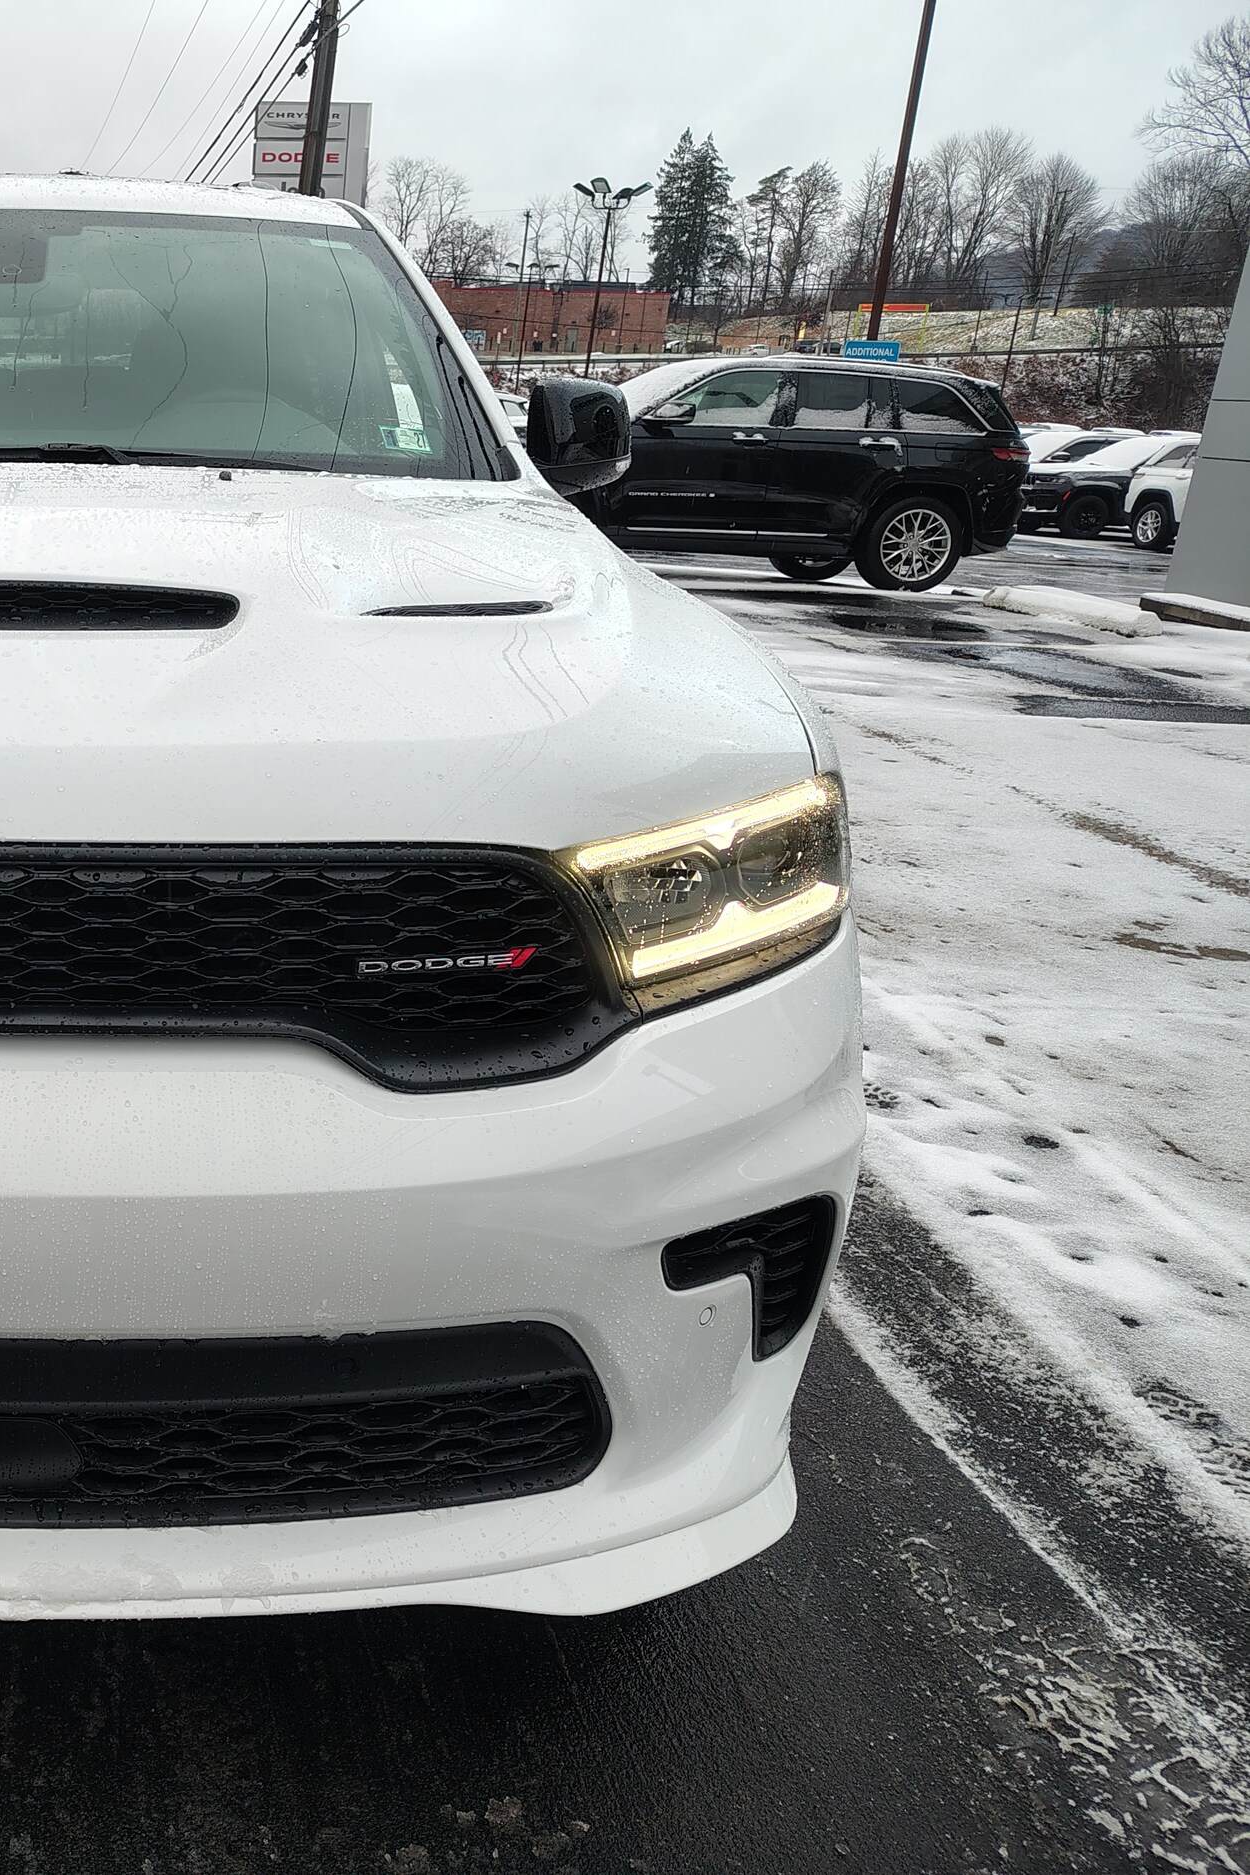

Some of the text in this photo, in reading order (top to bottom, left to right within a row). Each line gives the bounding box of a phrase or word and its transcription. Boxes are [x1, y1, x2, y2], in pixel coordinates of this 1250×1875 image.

[261, 152, 340, 163] DODE
[845, 347, 895, 357] ADDITIONAL
[358, 953, 514, 974] DODGE
